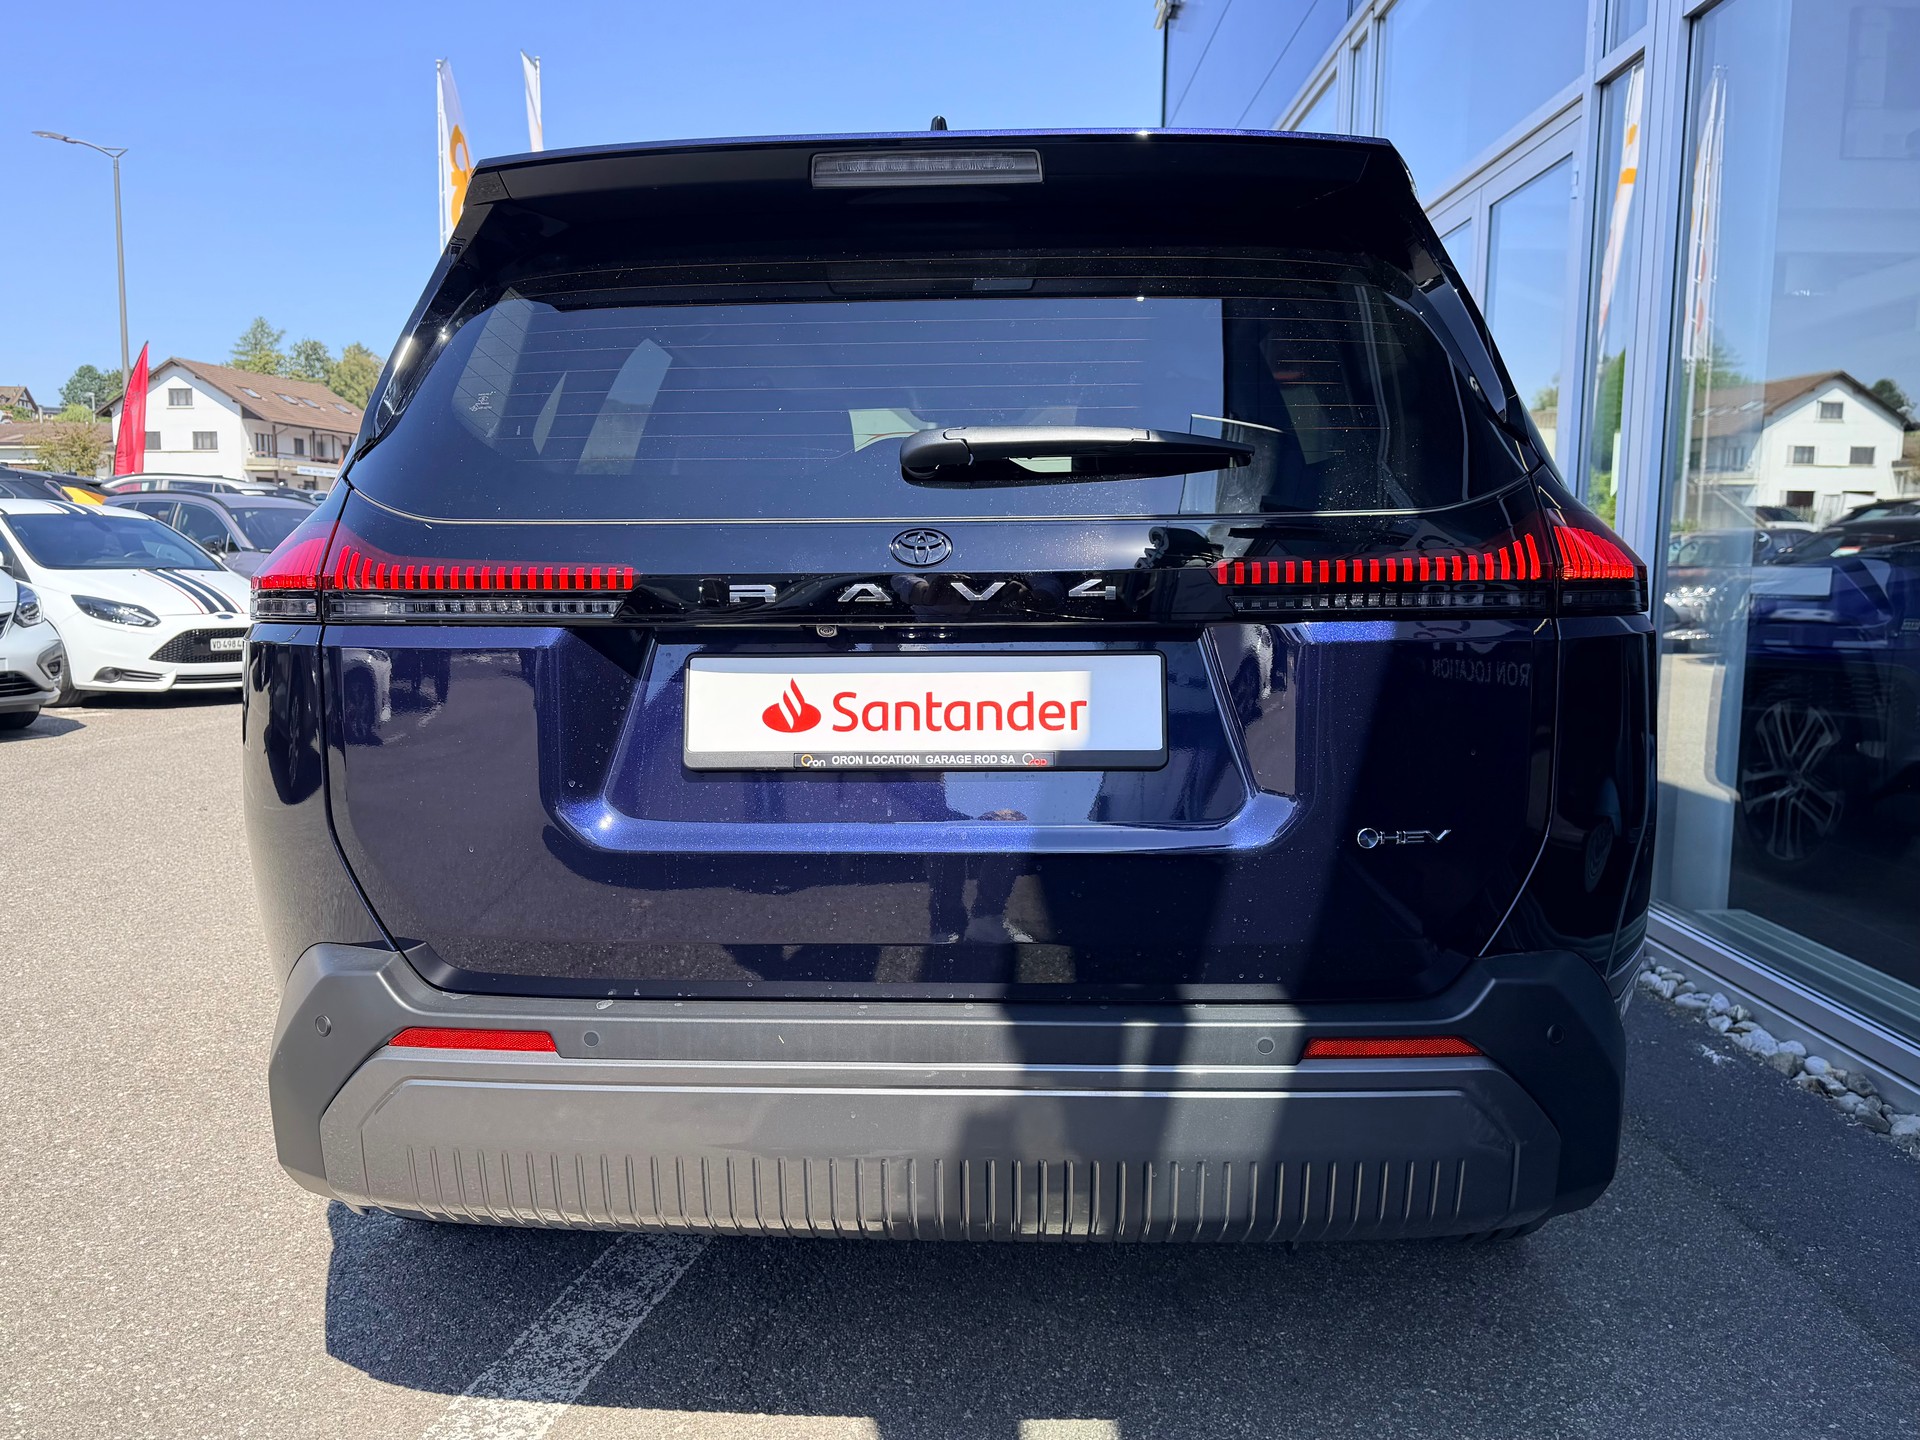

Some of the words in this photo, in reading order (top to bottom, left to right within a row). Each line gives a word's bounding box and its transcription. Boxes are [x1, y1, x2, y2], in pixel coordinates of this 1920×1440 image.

[729, 579, 1117, 603] RAV4
[212, 640, 222, 649] VD
[832, 691, 1087, 732] Santander
[831, 755, 863, 765] ORON
[866, 755, 920, 765] LOCATION
[925, 755, 972, 764] GARAGE
[974, 755, 998, 764] ROD
[1000, 755, 1016, 764] SA
[1380, 829, 1452, 845] HEV
